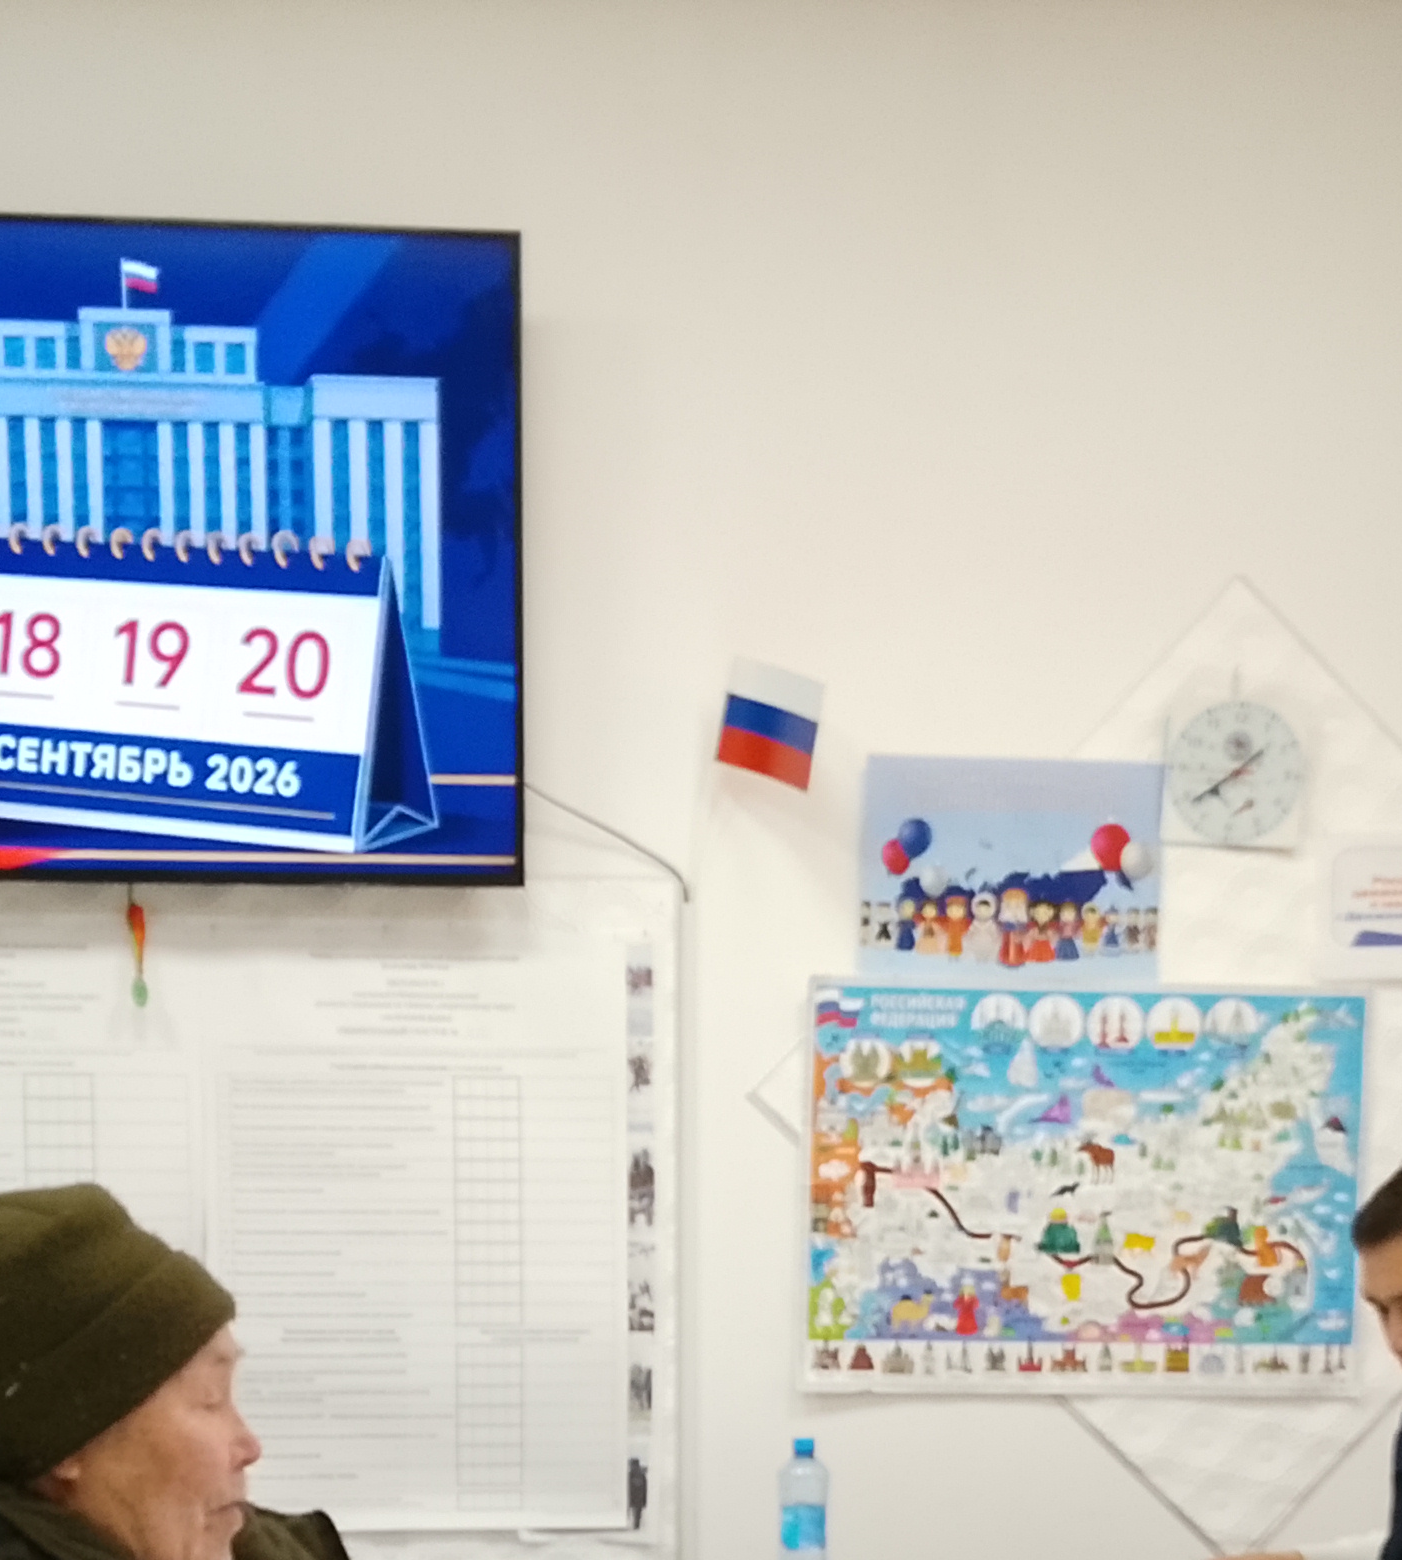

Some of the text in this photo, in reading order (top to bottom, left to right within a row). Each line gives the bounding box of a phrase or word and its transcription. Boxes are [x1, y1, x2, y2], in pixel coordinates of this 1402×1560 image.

[113, 619, 191, 688] 19
[236, 627, 331, 700] 20
[205, 753, 302, 798] 2026
